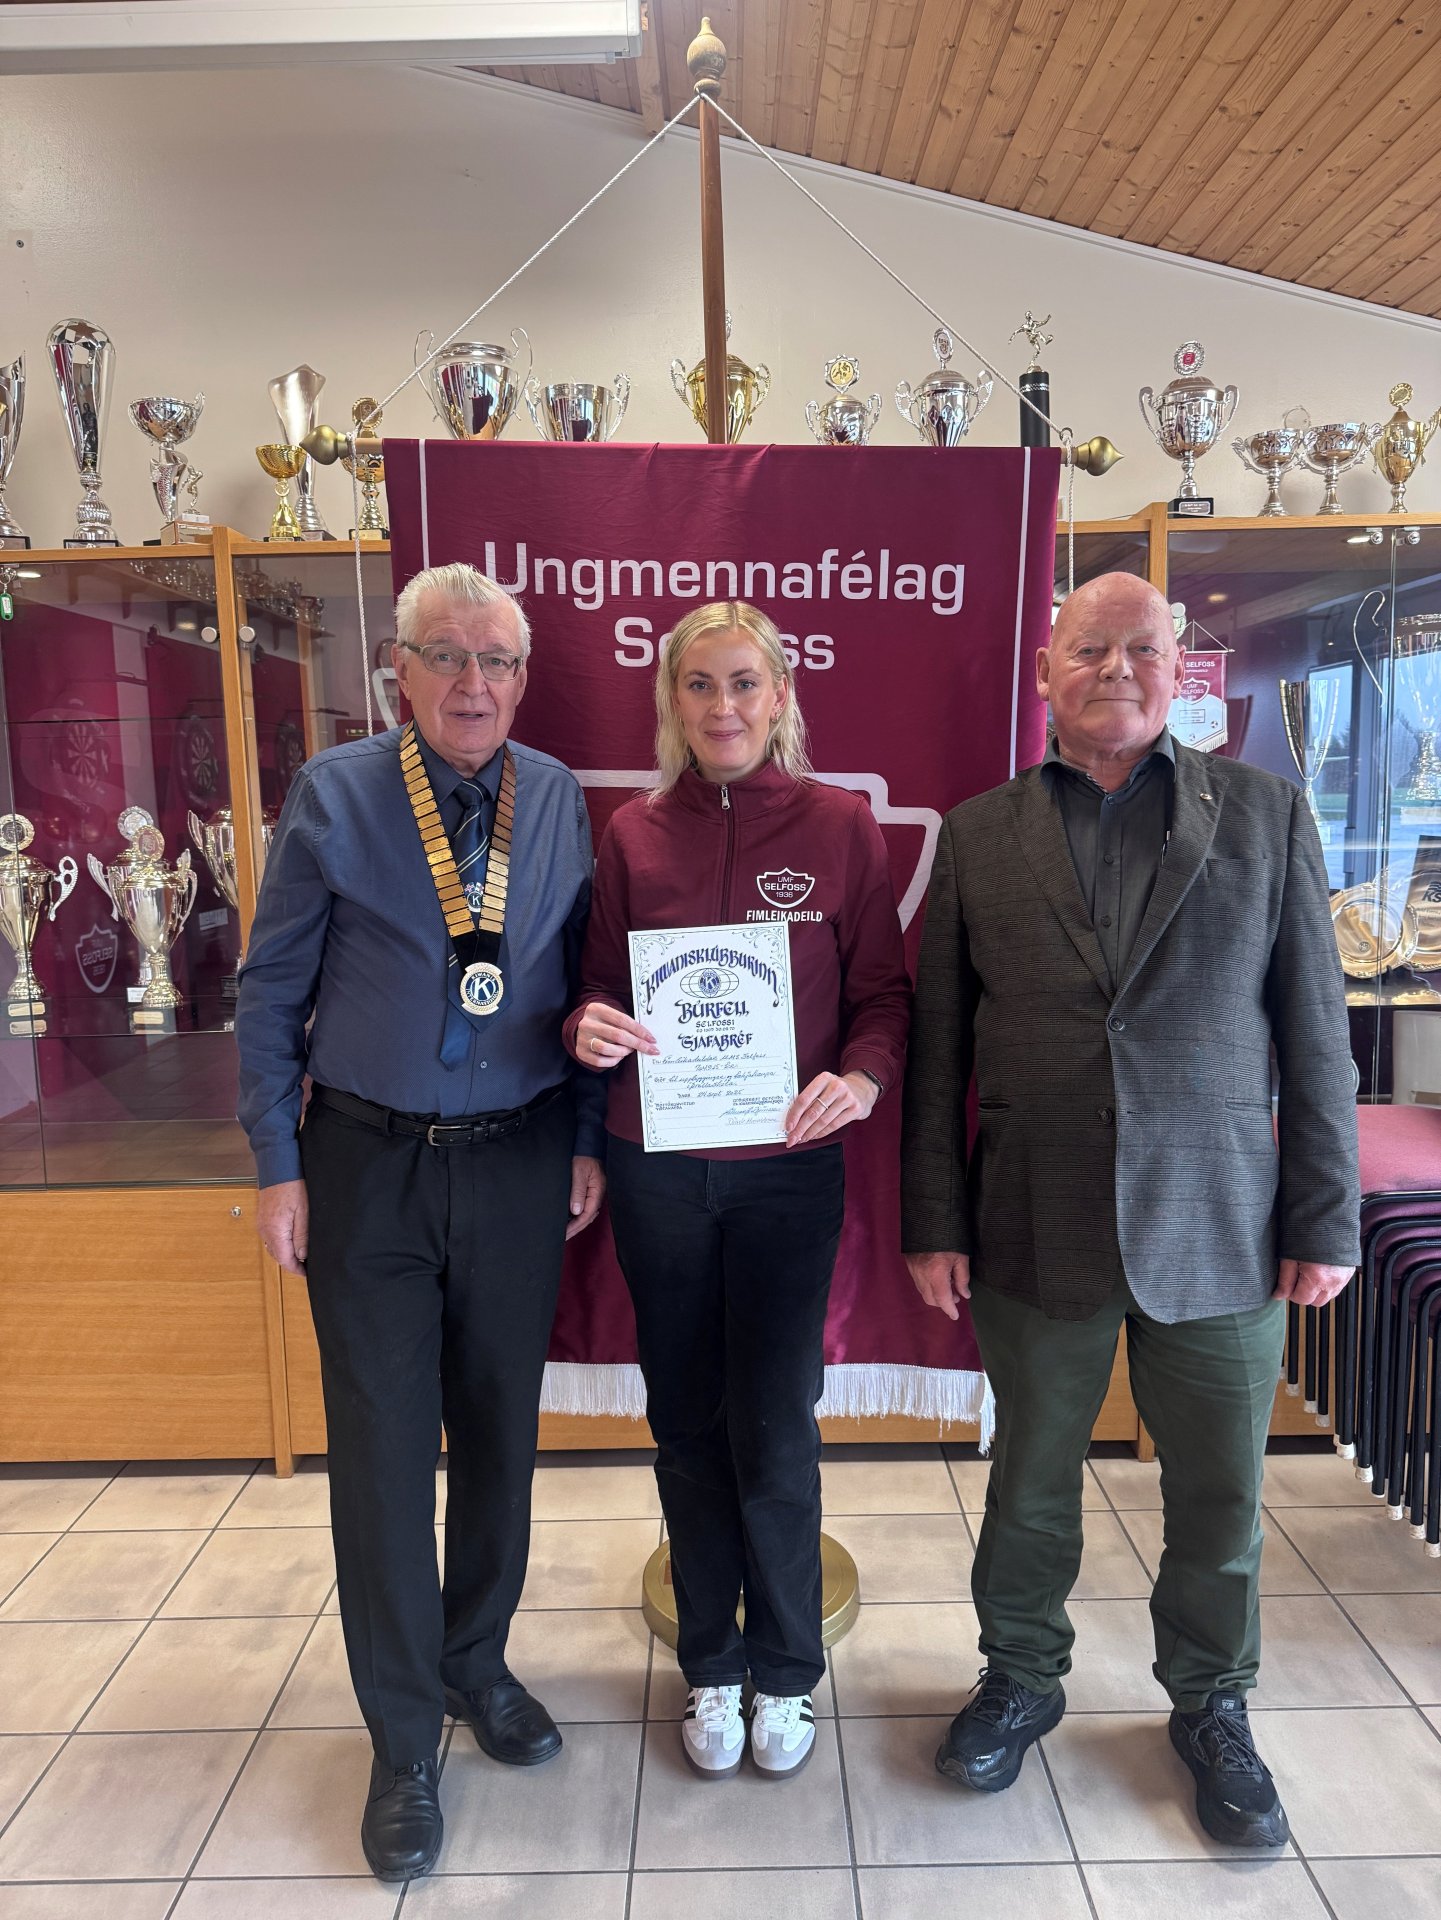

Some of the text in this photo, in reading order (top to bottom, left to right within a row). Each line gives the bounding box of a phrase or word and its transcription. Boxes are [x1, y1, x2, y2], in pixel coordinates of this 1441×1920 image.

[484, 541, 965, 615] Ungmennafélag
[1186, 660, 1215, 668] SELFOSS
[764, 882, 807, 891] SELFOSS
[746, 910, 823, 922] FIMLEIKADEILD
